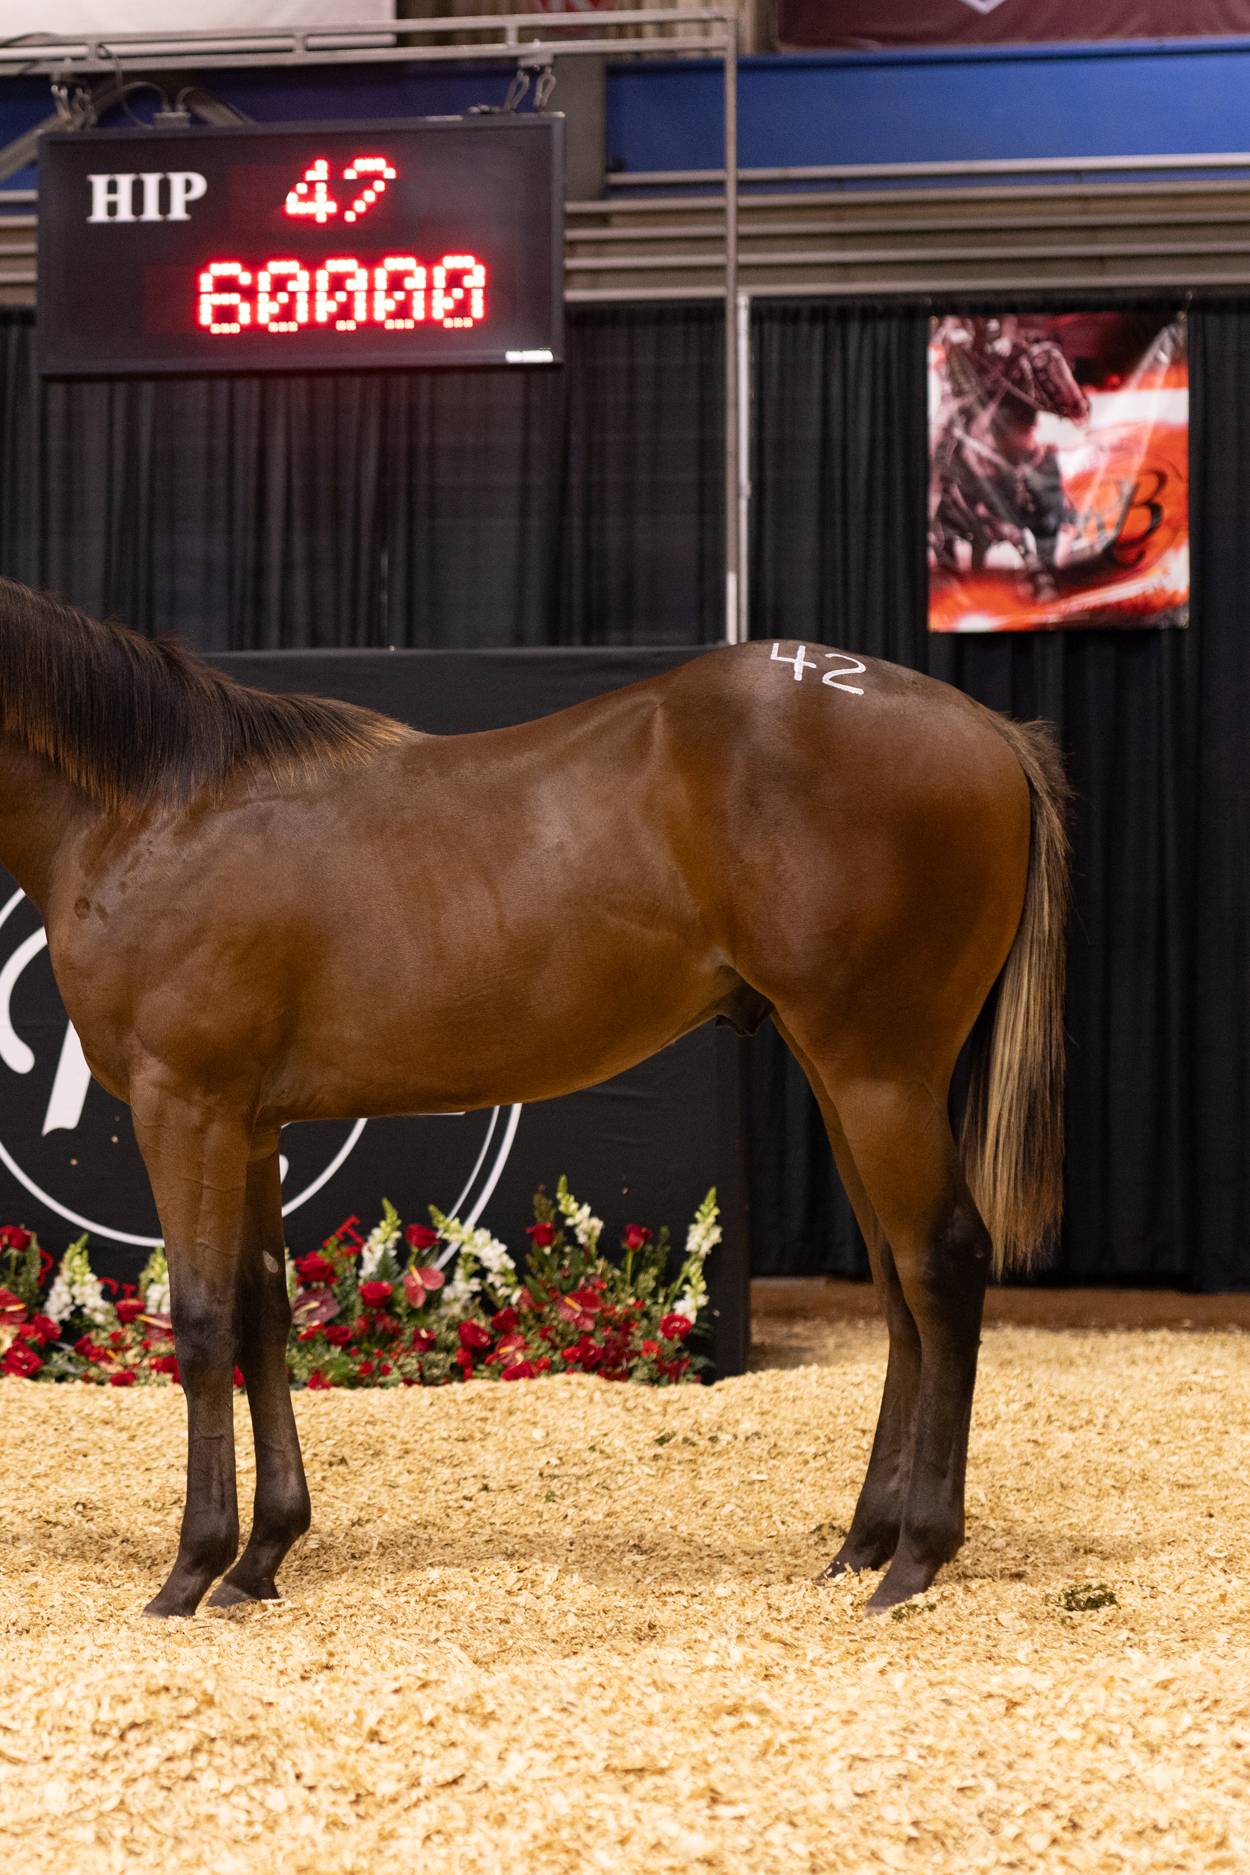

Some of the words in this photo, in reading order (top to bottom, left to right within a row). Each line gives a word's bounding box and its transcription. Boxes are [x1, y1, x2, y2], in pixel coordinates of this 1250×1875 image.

[86, 171, 208, 224] HIP
[198, 254, 487, 335] 60000
[770, 642, 867, 696] 42
